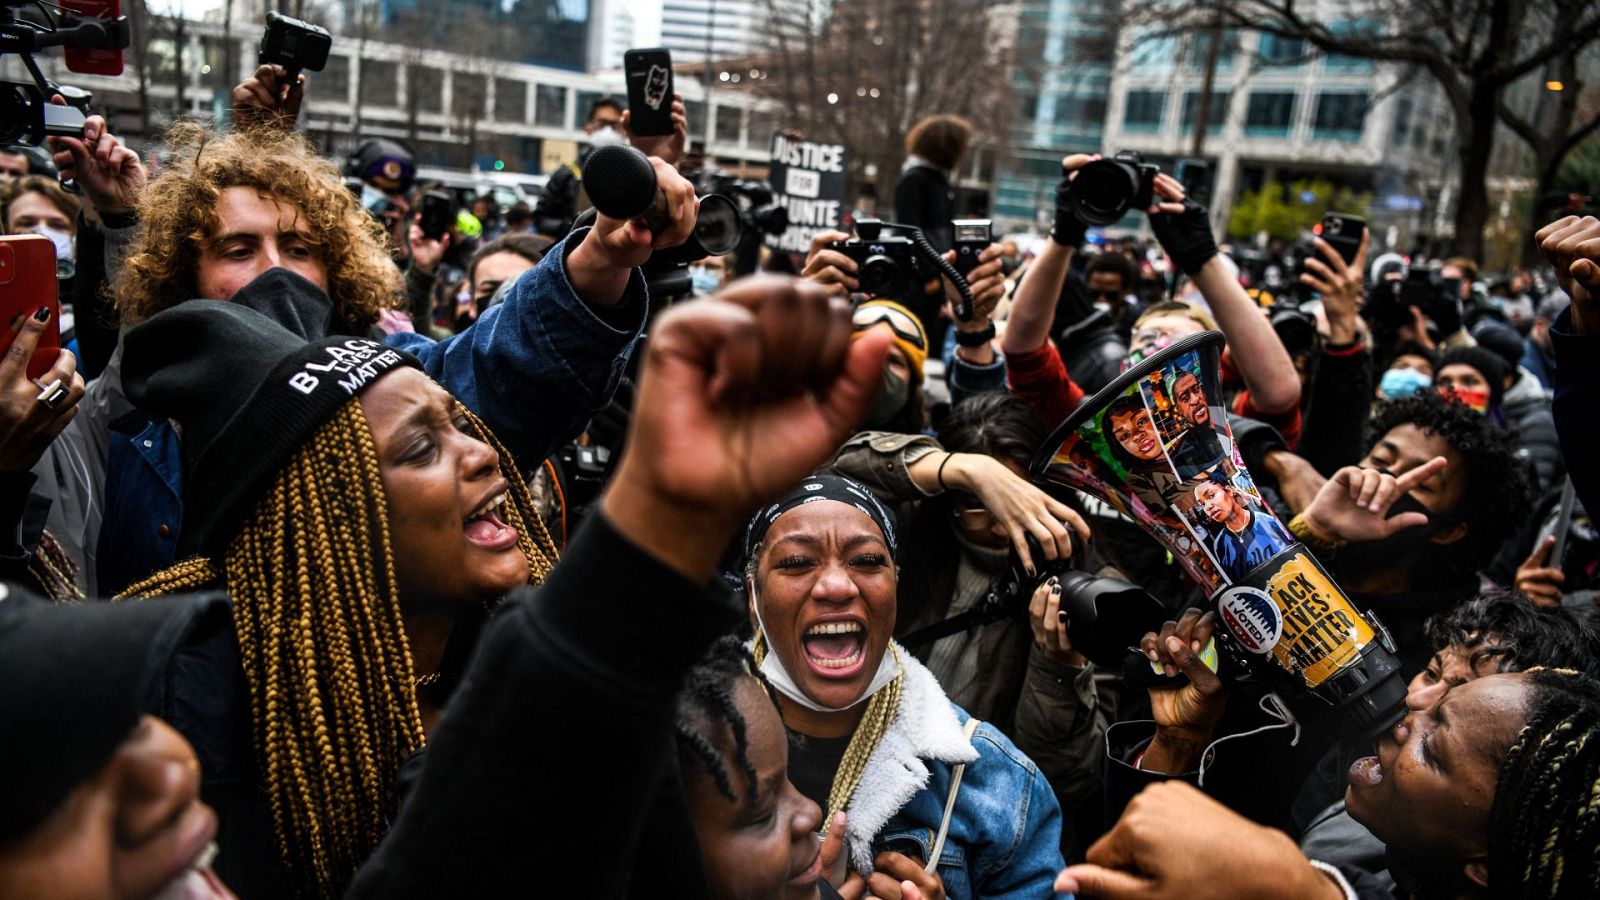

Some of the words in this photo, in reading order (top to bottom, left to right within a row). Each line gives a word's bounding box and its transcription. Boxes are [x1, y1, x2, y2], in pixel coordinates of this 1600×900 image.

[774, 136, 845, 172] JUSTICE
[772, 193, 840, 227] UNTE
[334, 348, 378, 372] LIVES
[337, 349, 402, 394] MATTER
[1271, 572, 1316, 616] ACK
[1233, 607, 1266, 644] VOTED!
